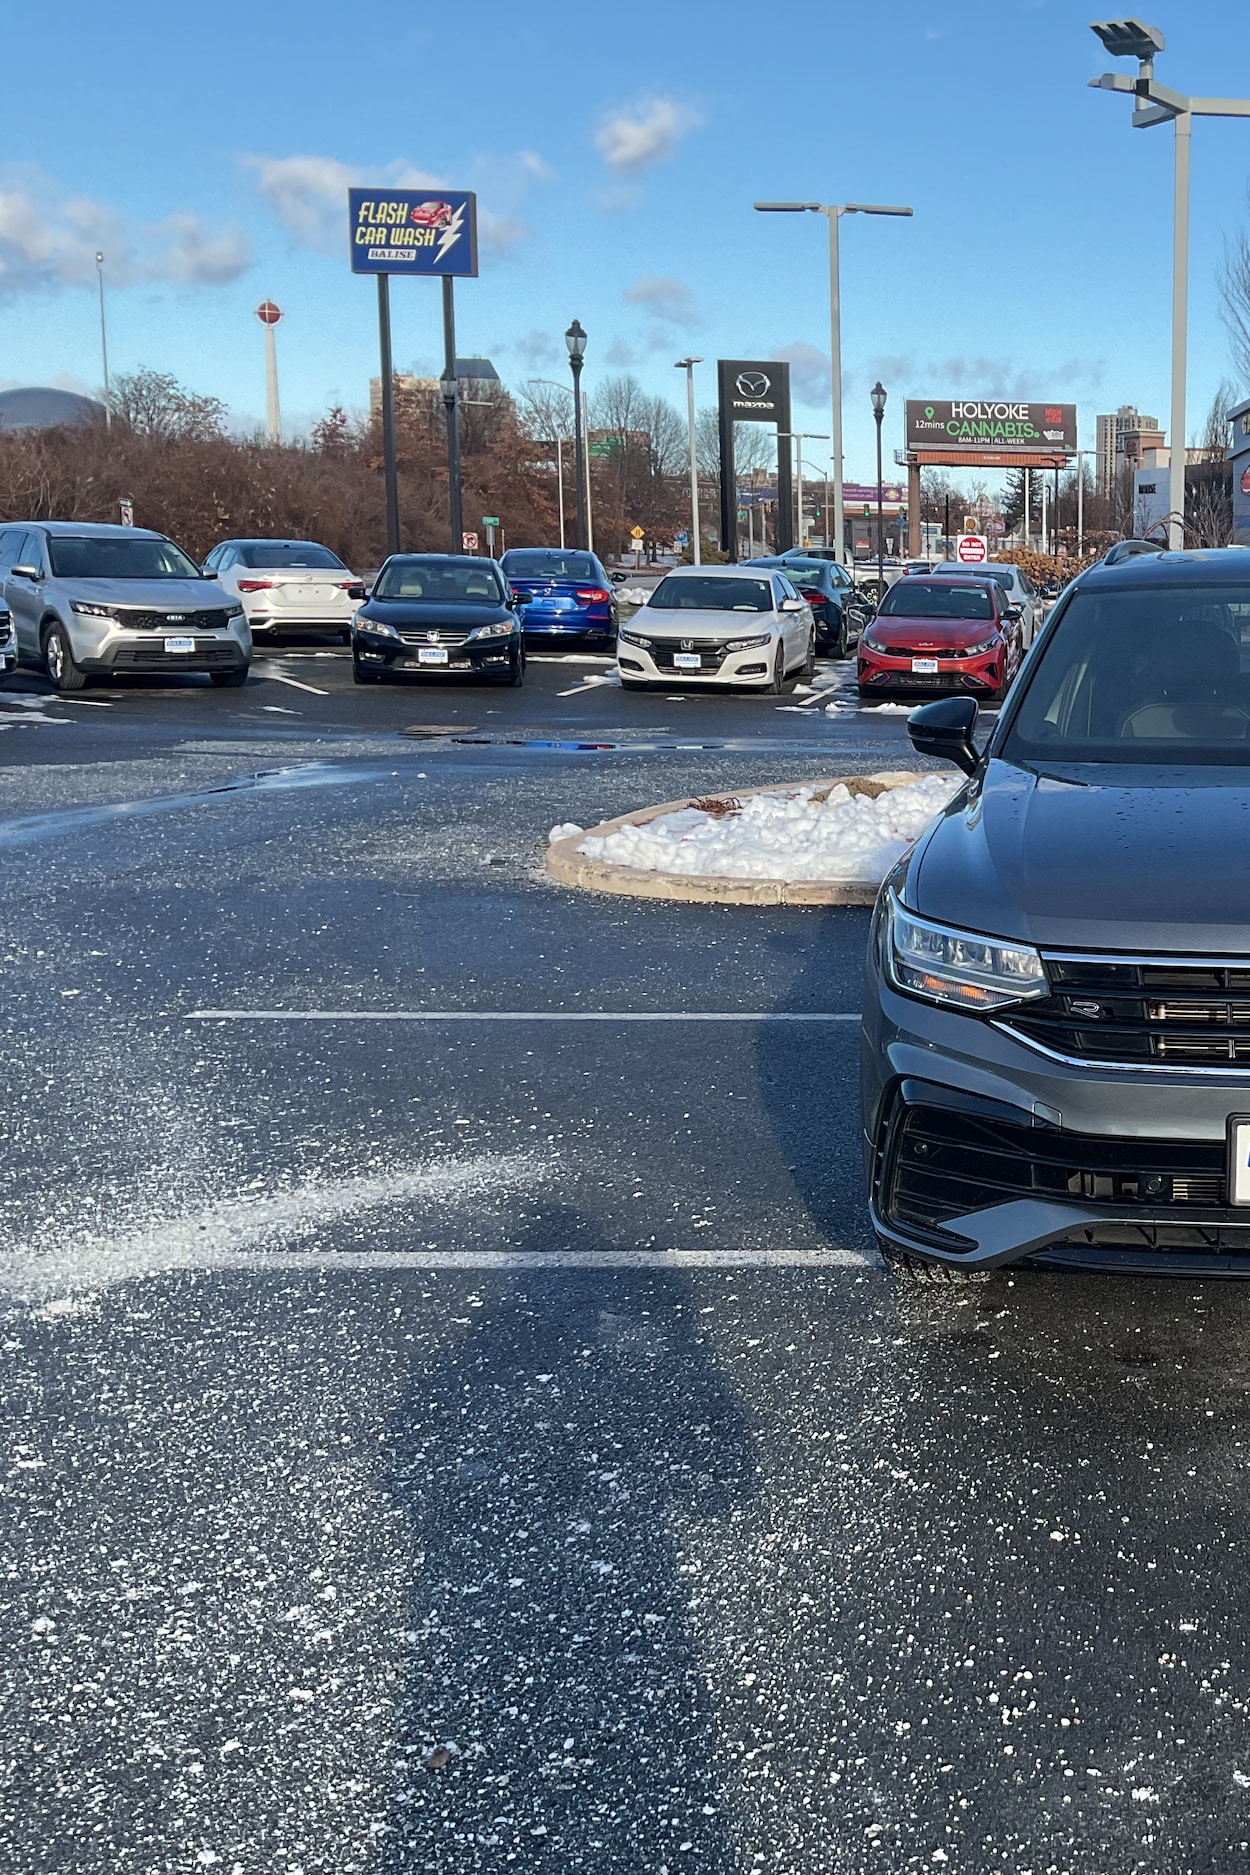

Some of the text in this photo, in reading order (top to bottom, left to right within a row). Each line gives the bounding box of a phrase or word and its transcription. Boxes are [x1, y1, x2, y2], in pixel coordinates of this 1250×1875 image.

[358, 201, 409, 225] FLASH
[355, 227, 436, 247] CAR WASH
[370, 250, 415, 259] BALISE
[733, 401, 775, 409] mazda
[951, 402, 1029, 420] HOLYOKE
